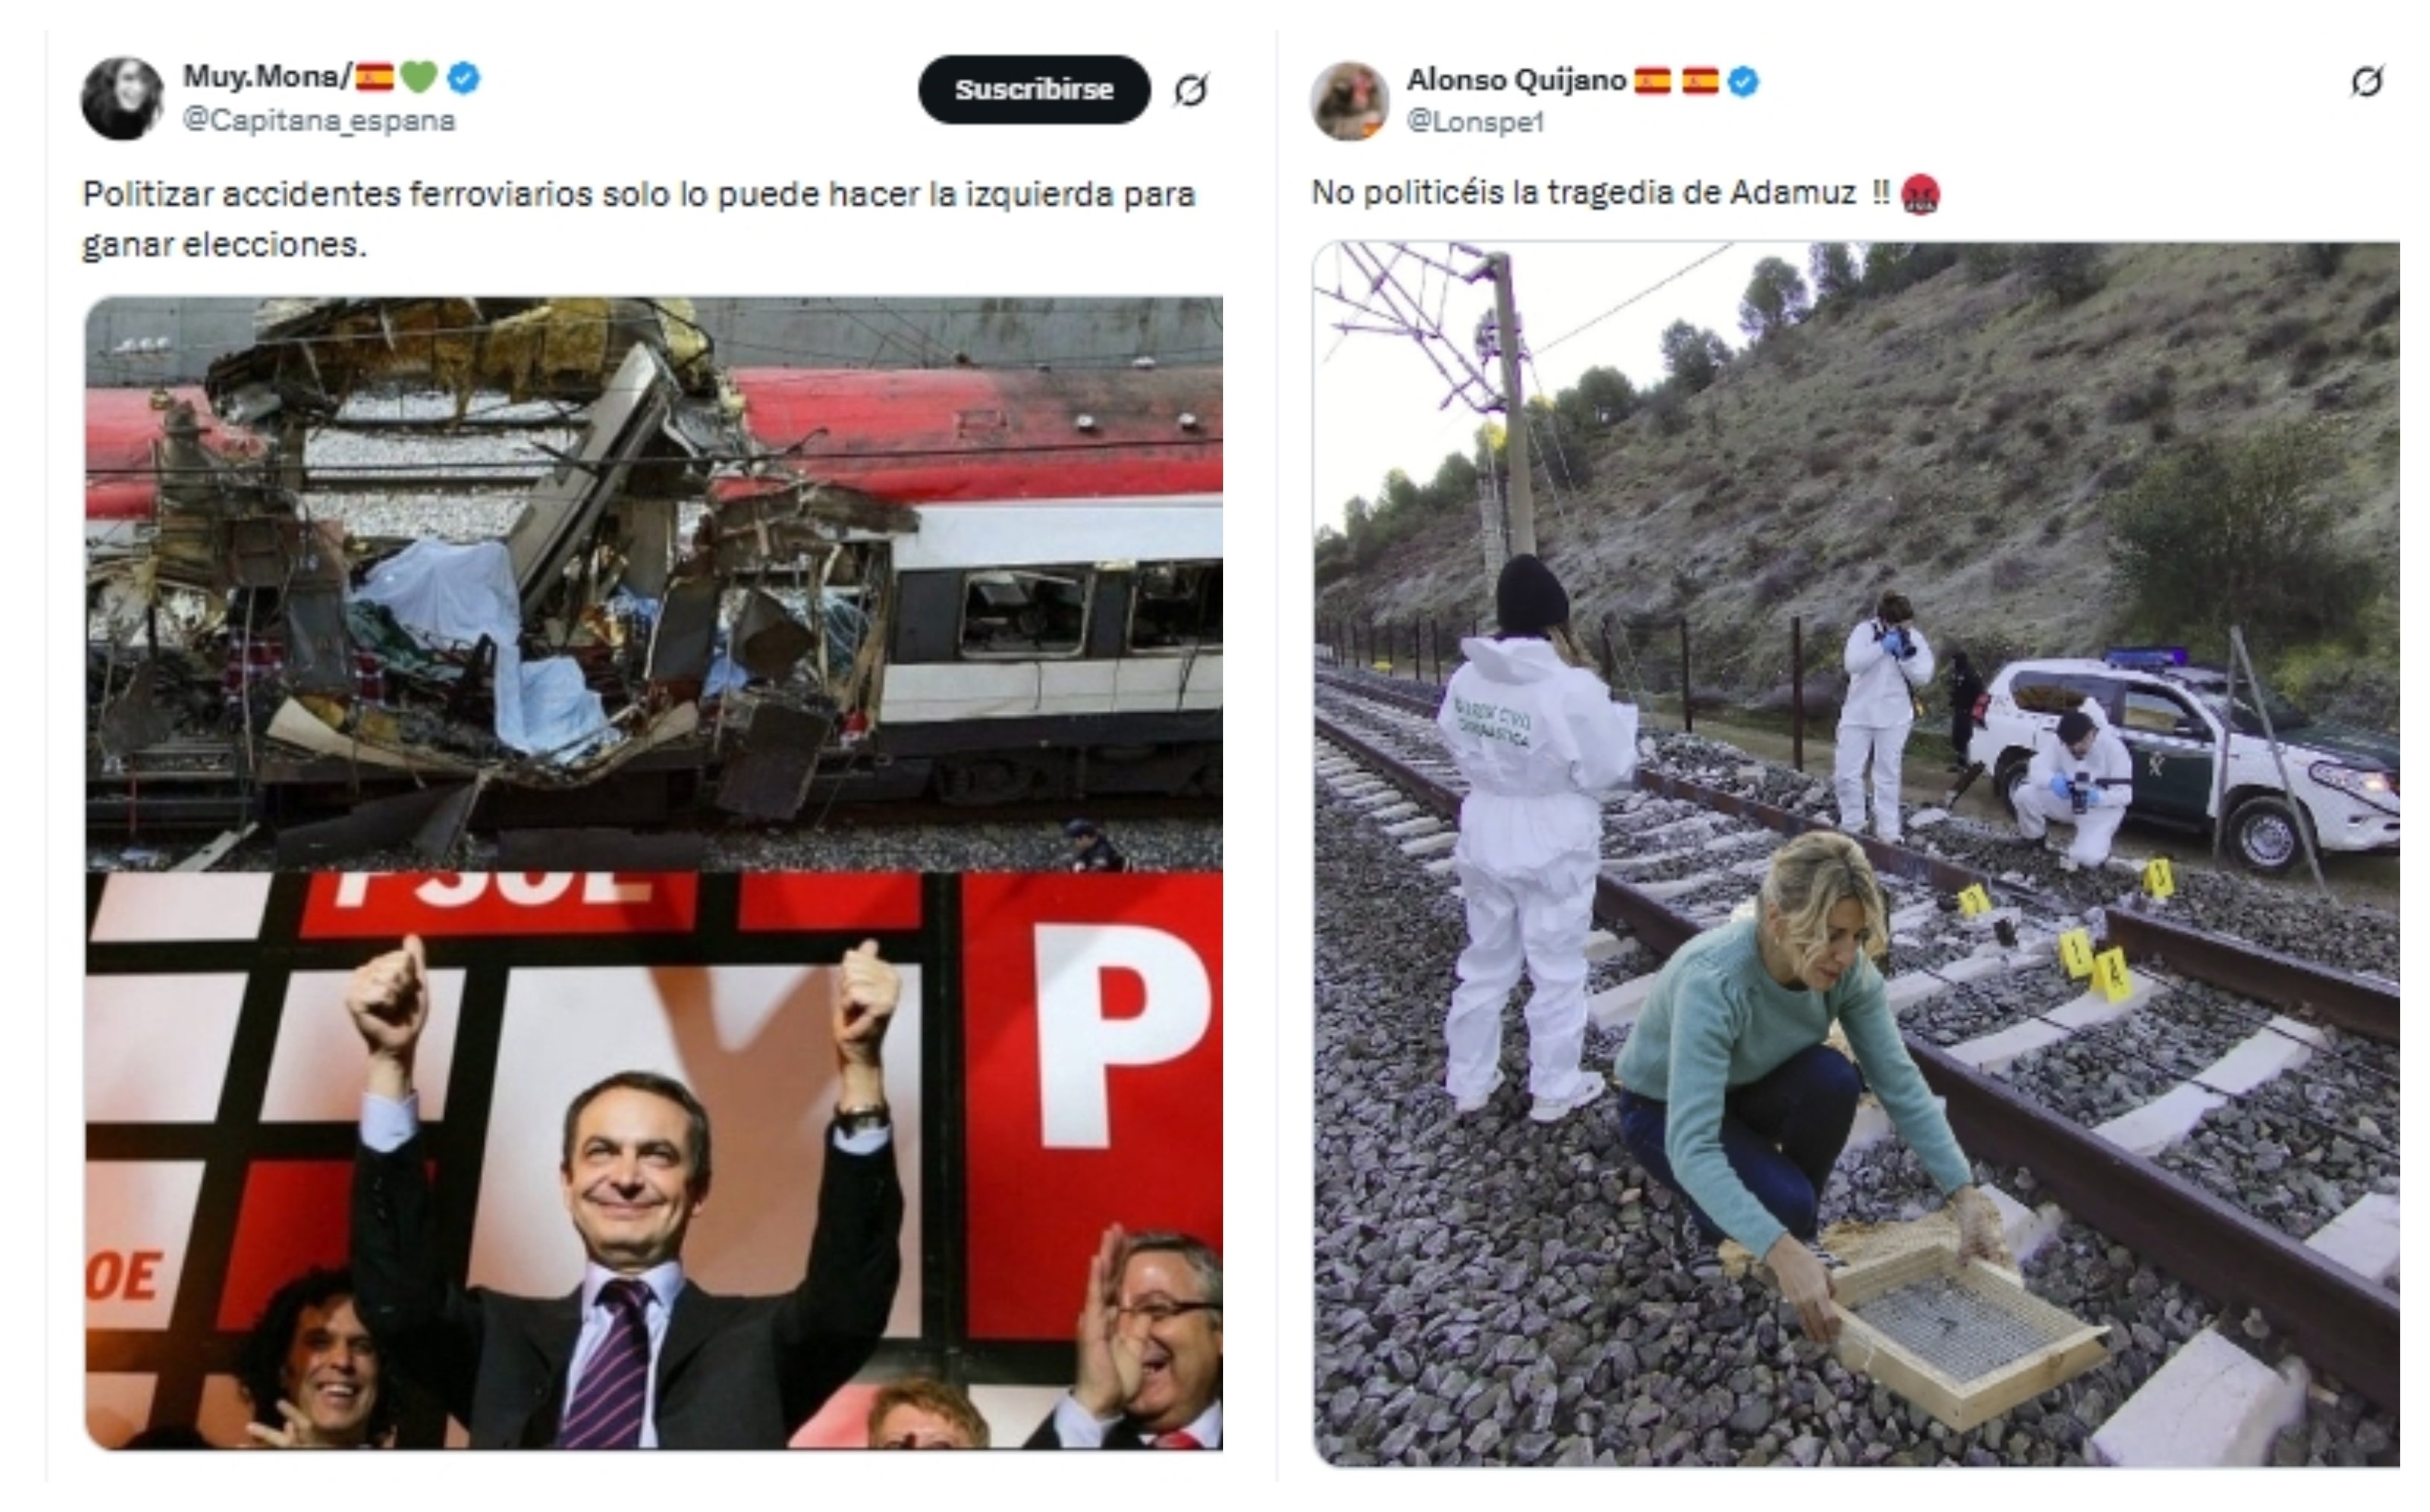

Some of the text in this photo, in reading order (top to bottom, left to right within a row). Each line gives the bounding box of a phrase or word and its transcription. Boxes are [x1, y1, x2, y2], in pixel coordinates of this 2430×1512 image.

[184, 61, 354, 94] Muy.Mona/
[956, 77, 1114, 100] Suscribirse
[1407, 66, 1627, 97] Alonso Quijano
[184, 105, 455, 137] @Capitana_espana
[1408, 107, 1543, 137] @Lonspe1
[83, 179, 1196, 213] Politizar accidentes ferroviarios solo lo puede hacer la izquierda para
[1313, 176, 1890, 211] No politicéis la tragedia de Adamuz !!
[82, 231, 366, 264] ganar elecciones.
[1034, 922, 1212, 1149] P
